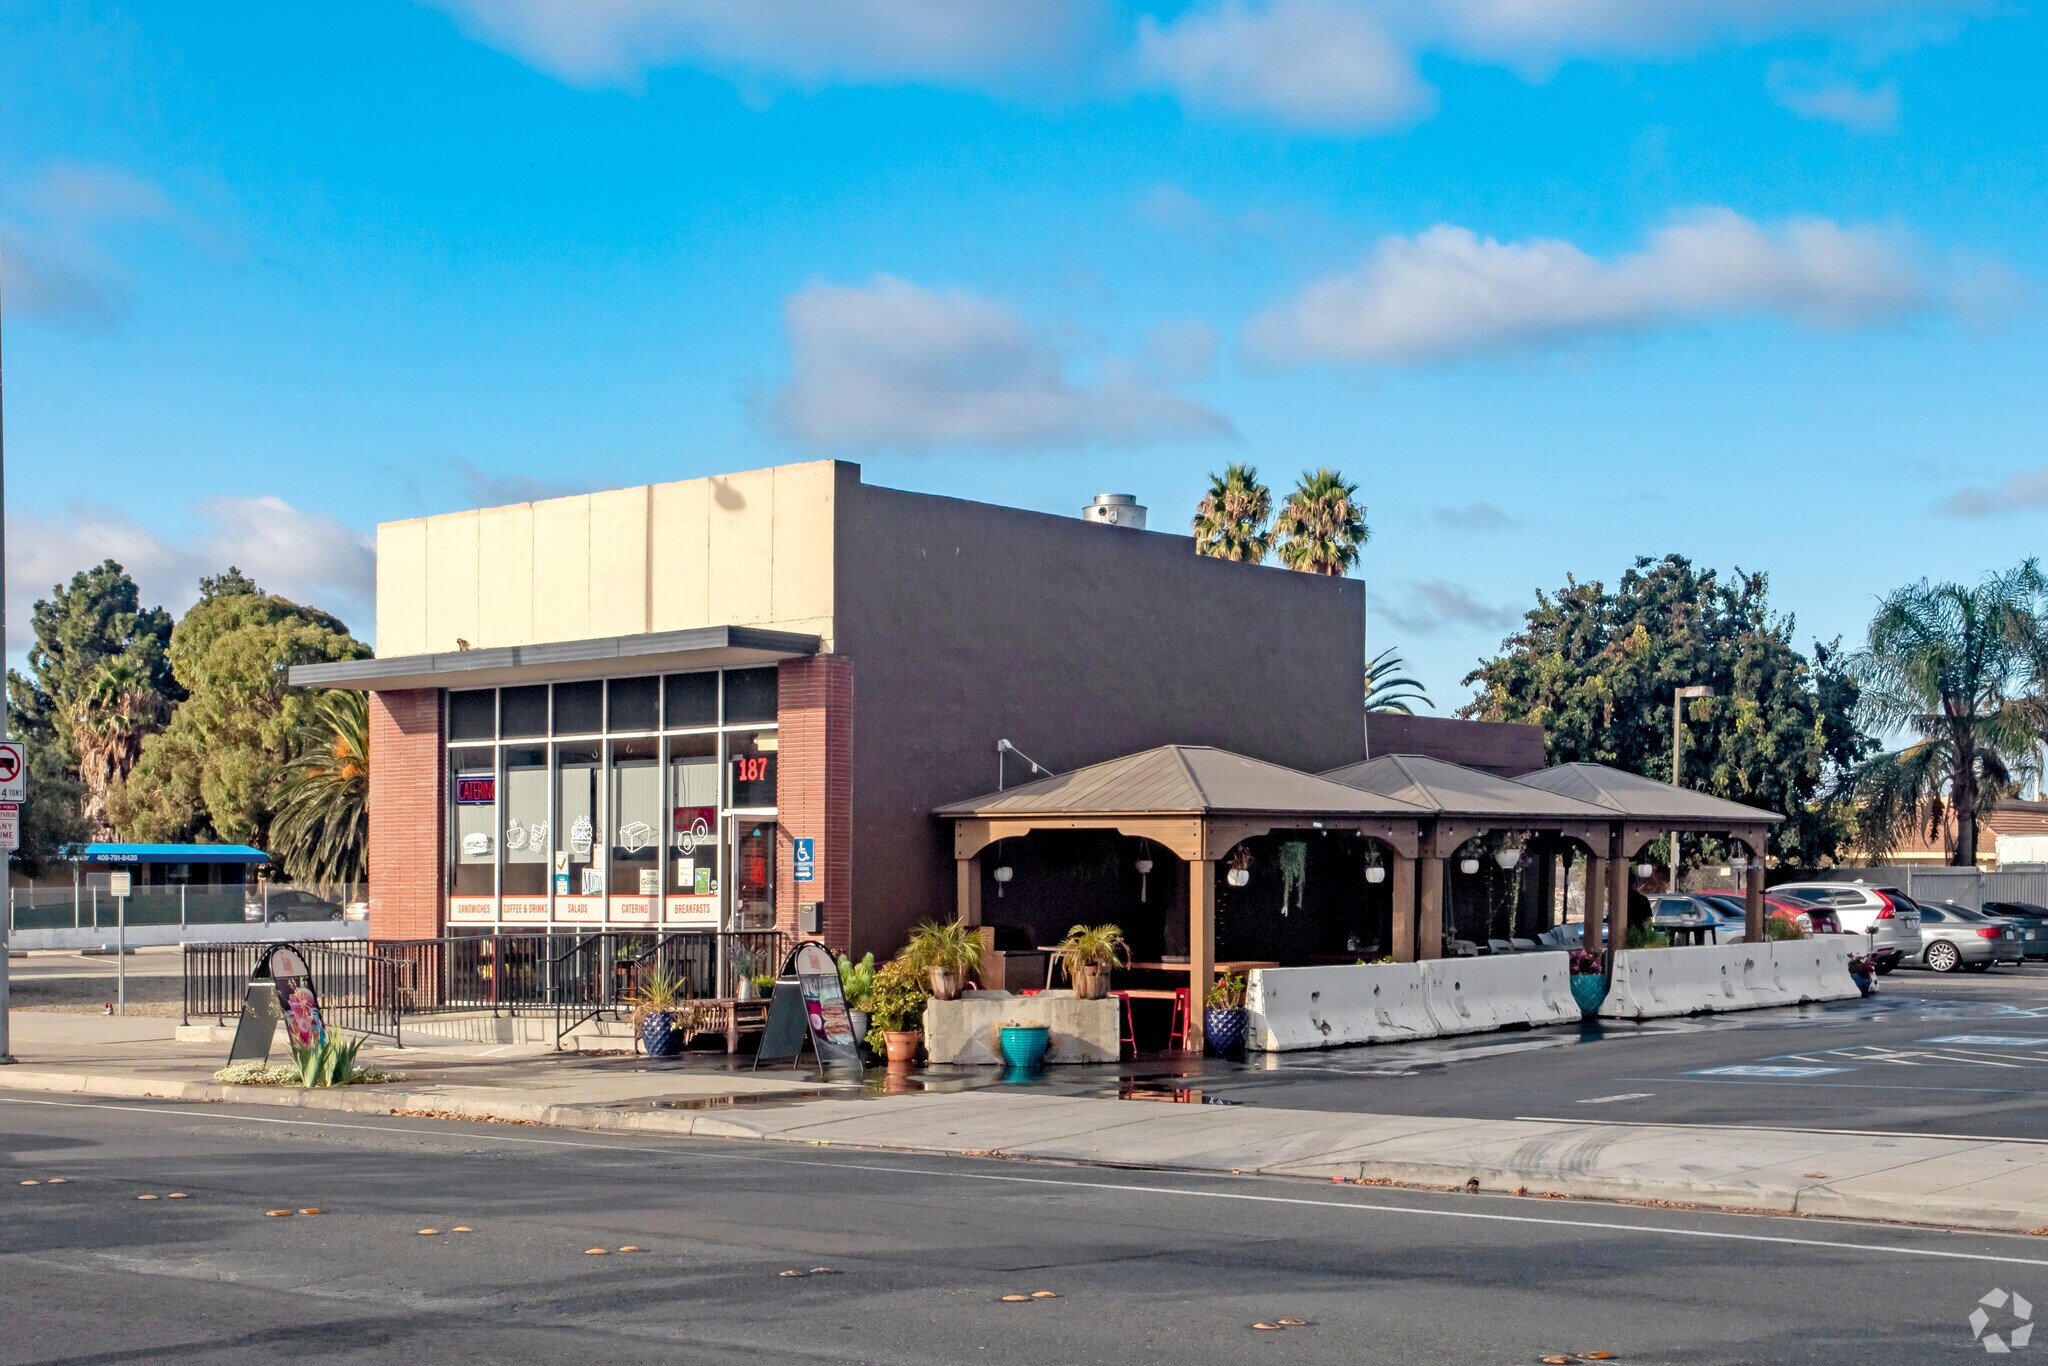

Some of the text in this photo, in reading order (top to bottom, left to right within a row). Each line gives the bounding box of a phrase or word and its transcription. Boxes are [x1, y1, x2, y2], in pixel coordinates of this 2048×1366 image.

[739, 757, 767, 781] 187
[1, 788, 22, 798] 4 TONS
[458, 904, 490, 914] SANDWICHES
[503, 904, 548, 913] COFFEE & DRINKS
[568, 904, 588, 913] SALADS
[622, 904, 648, 913] CATERING
[675, 904, 710, 914] BREAKFASTS
